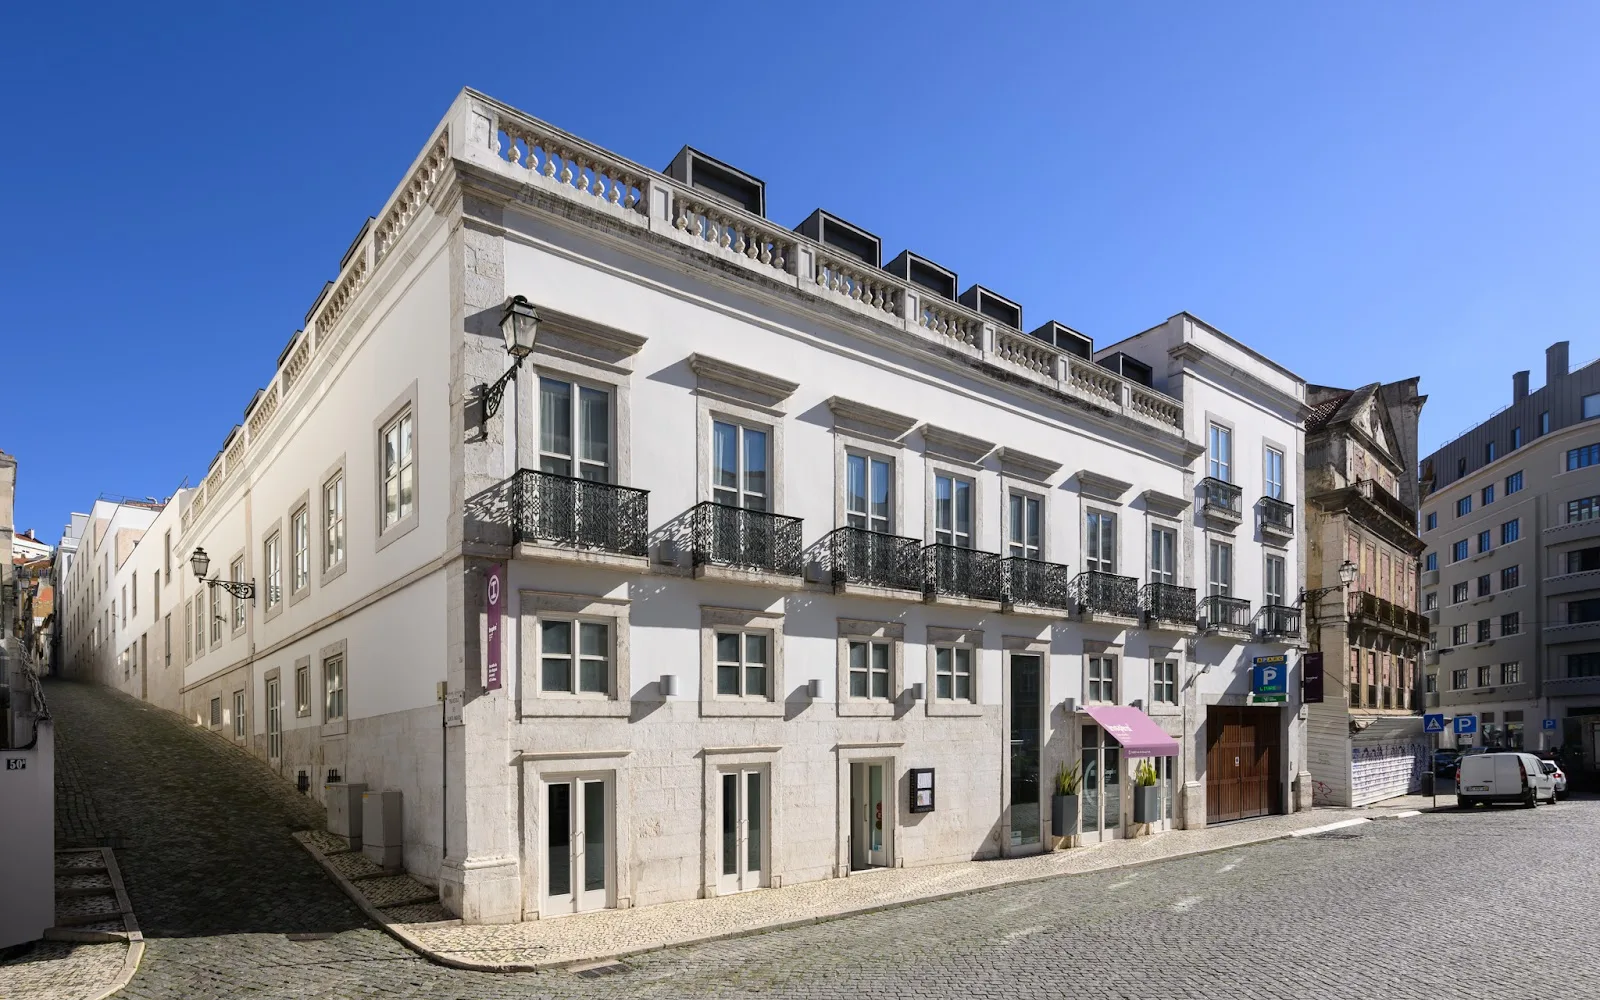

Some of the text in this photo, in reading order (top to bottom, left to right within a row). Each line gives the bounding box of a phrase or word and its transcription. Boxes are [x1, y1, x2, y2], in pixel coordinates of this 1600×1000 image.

[1263, 670, 1277, 685] P
[1459, 718, 1471, 732] P
[1545, 720, 1553, 728] P
